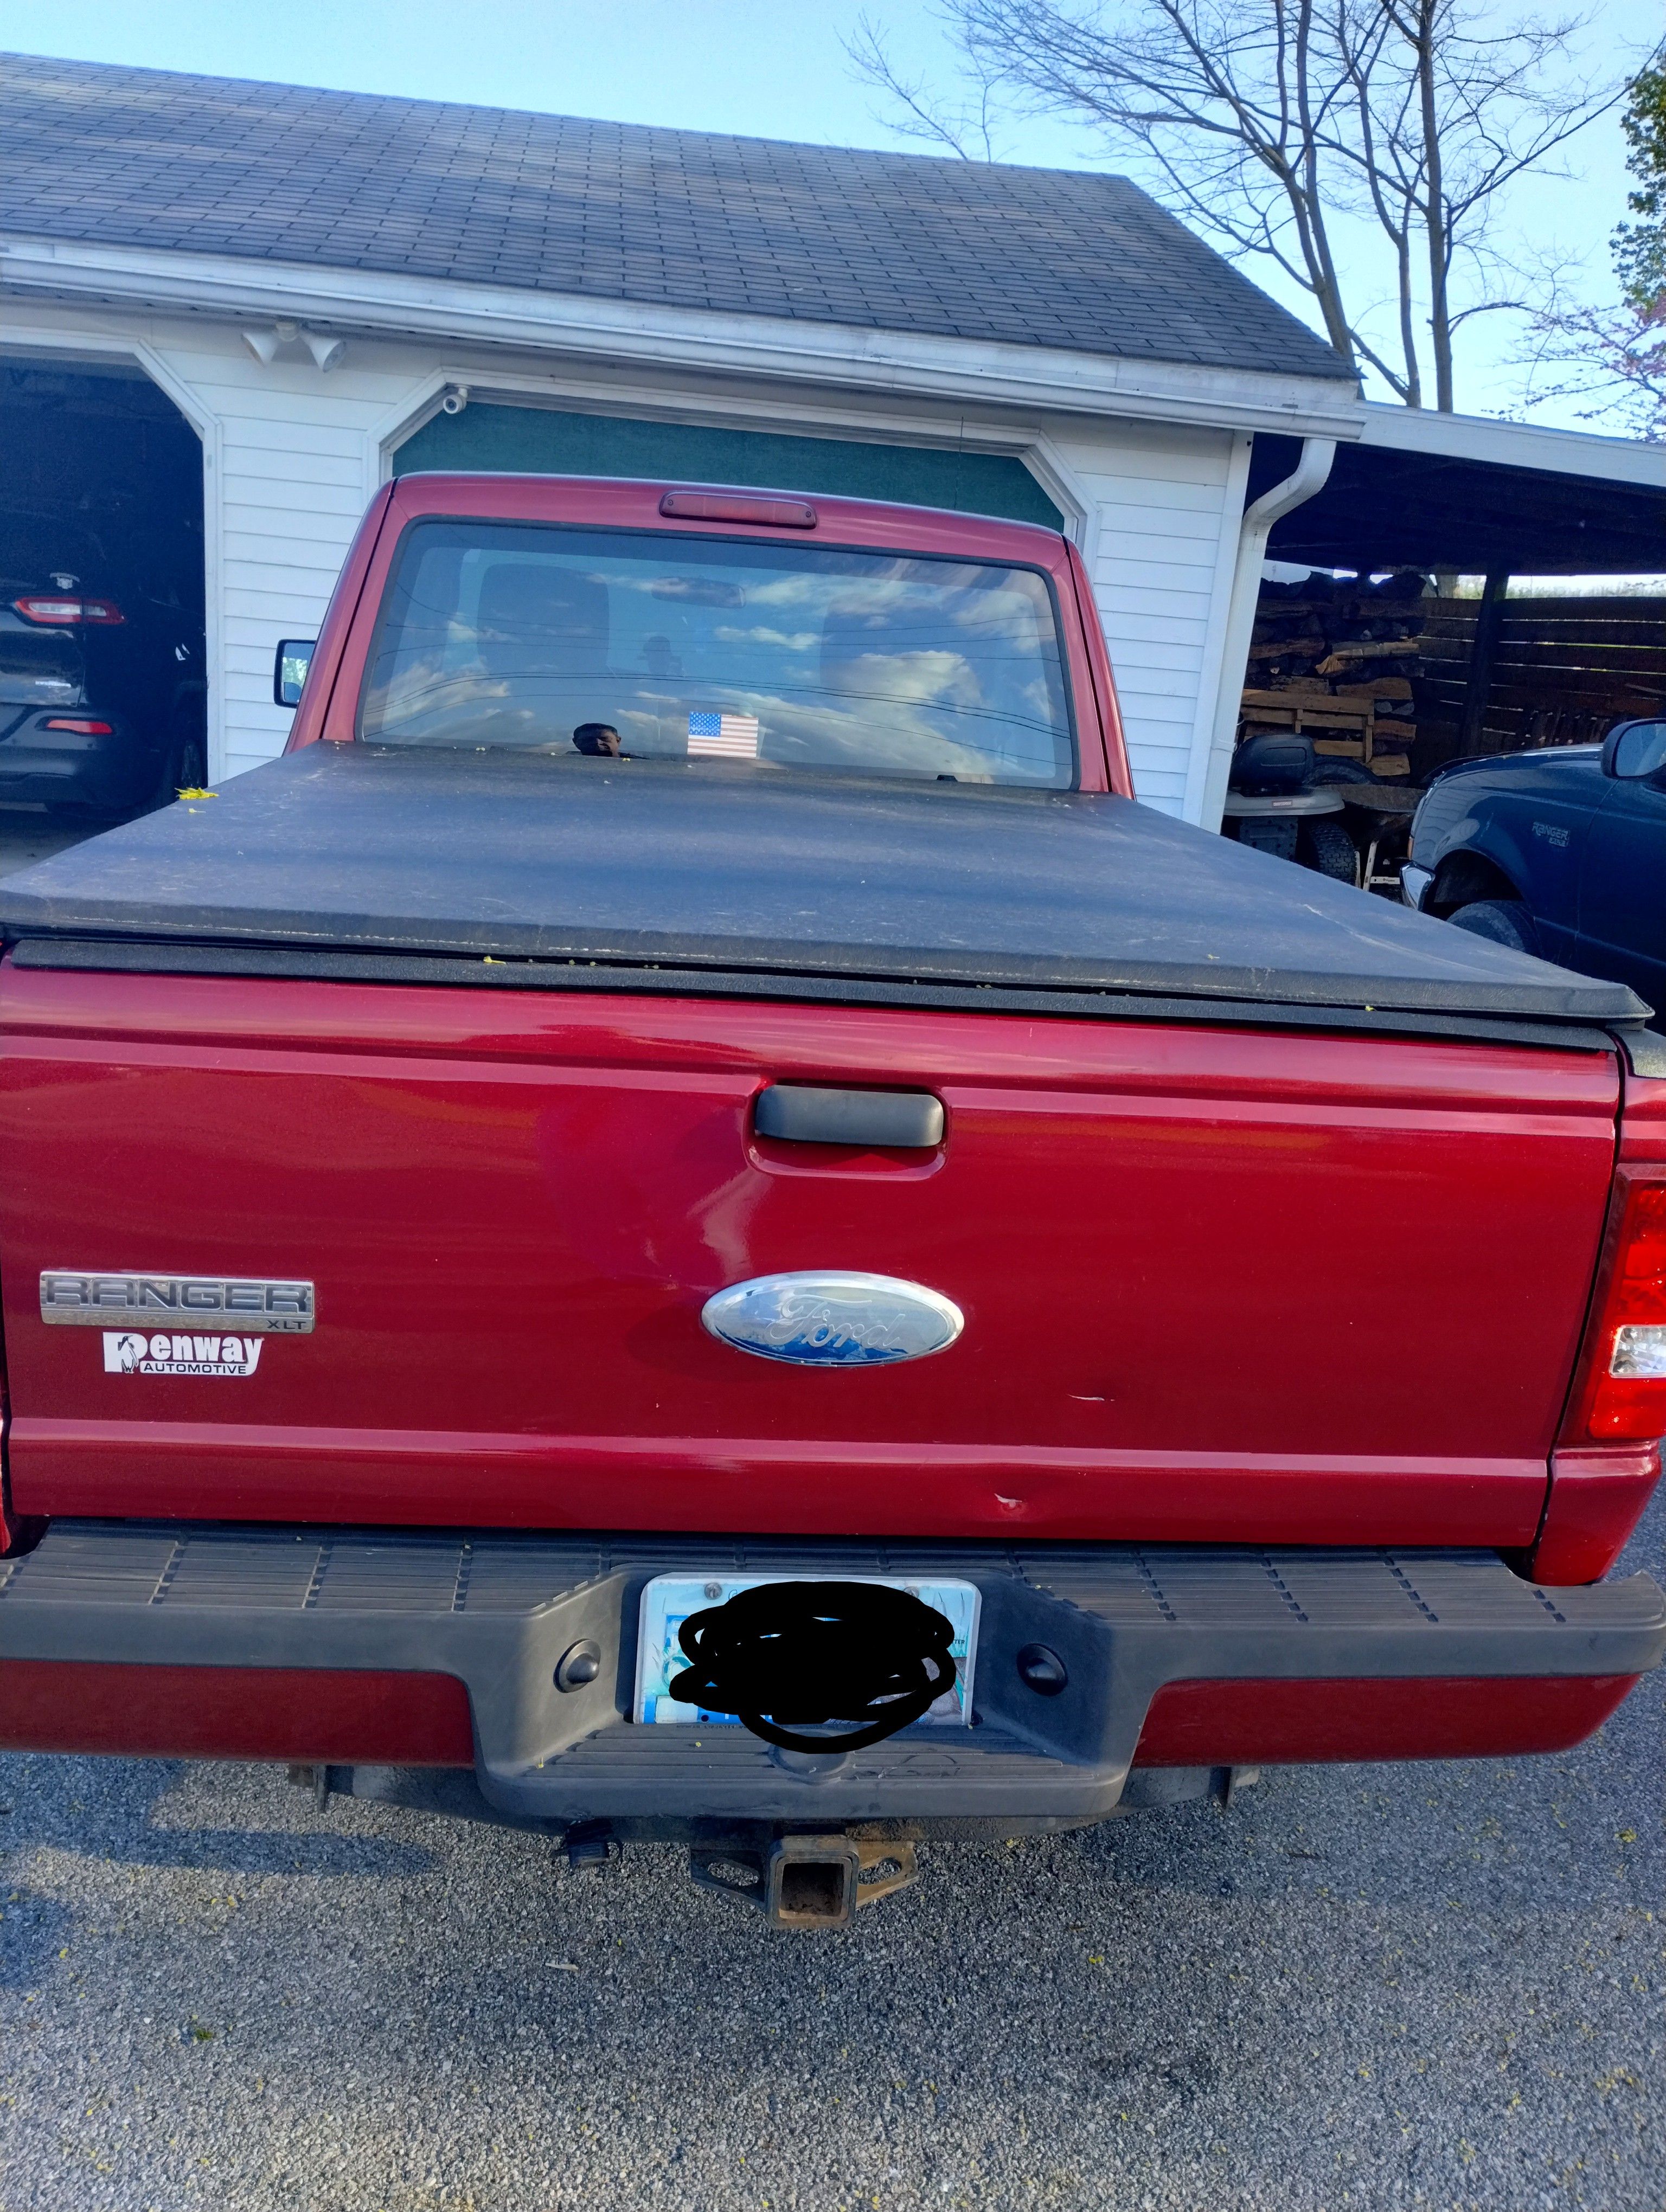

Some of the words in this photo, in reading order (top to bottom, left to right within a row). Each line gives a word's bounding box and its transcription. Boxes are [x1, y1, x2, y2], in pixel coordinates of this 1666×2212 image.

[46, 1276, 312, 1314] RANGER
[267, 1320, 307, 1330] XLT
[766, 1294, 906, 1348] Ford
[143, 1362, 247, 1374] AUTOMOTIVE
